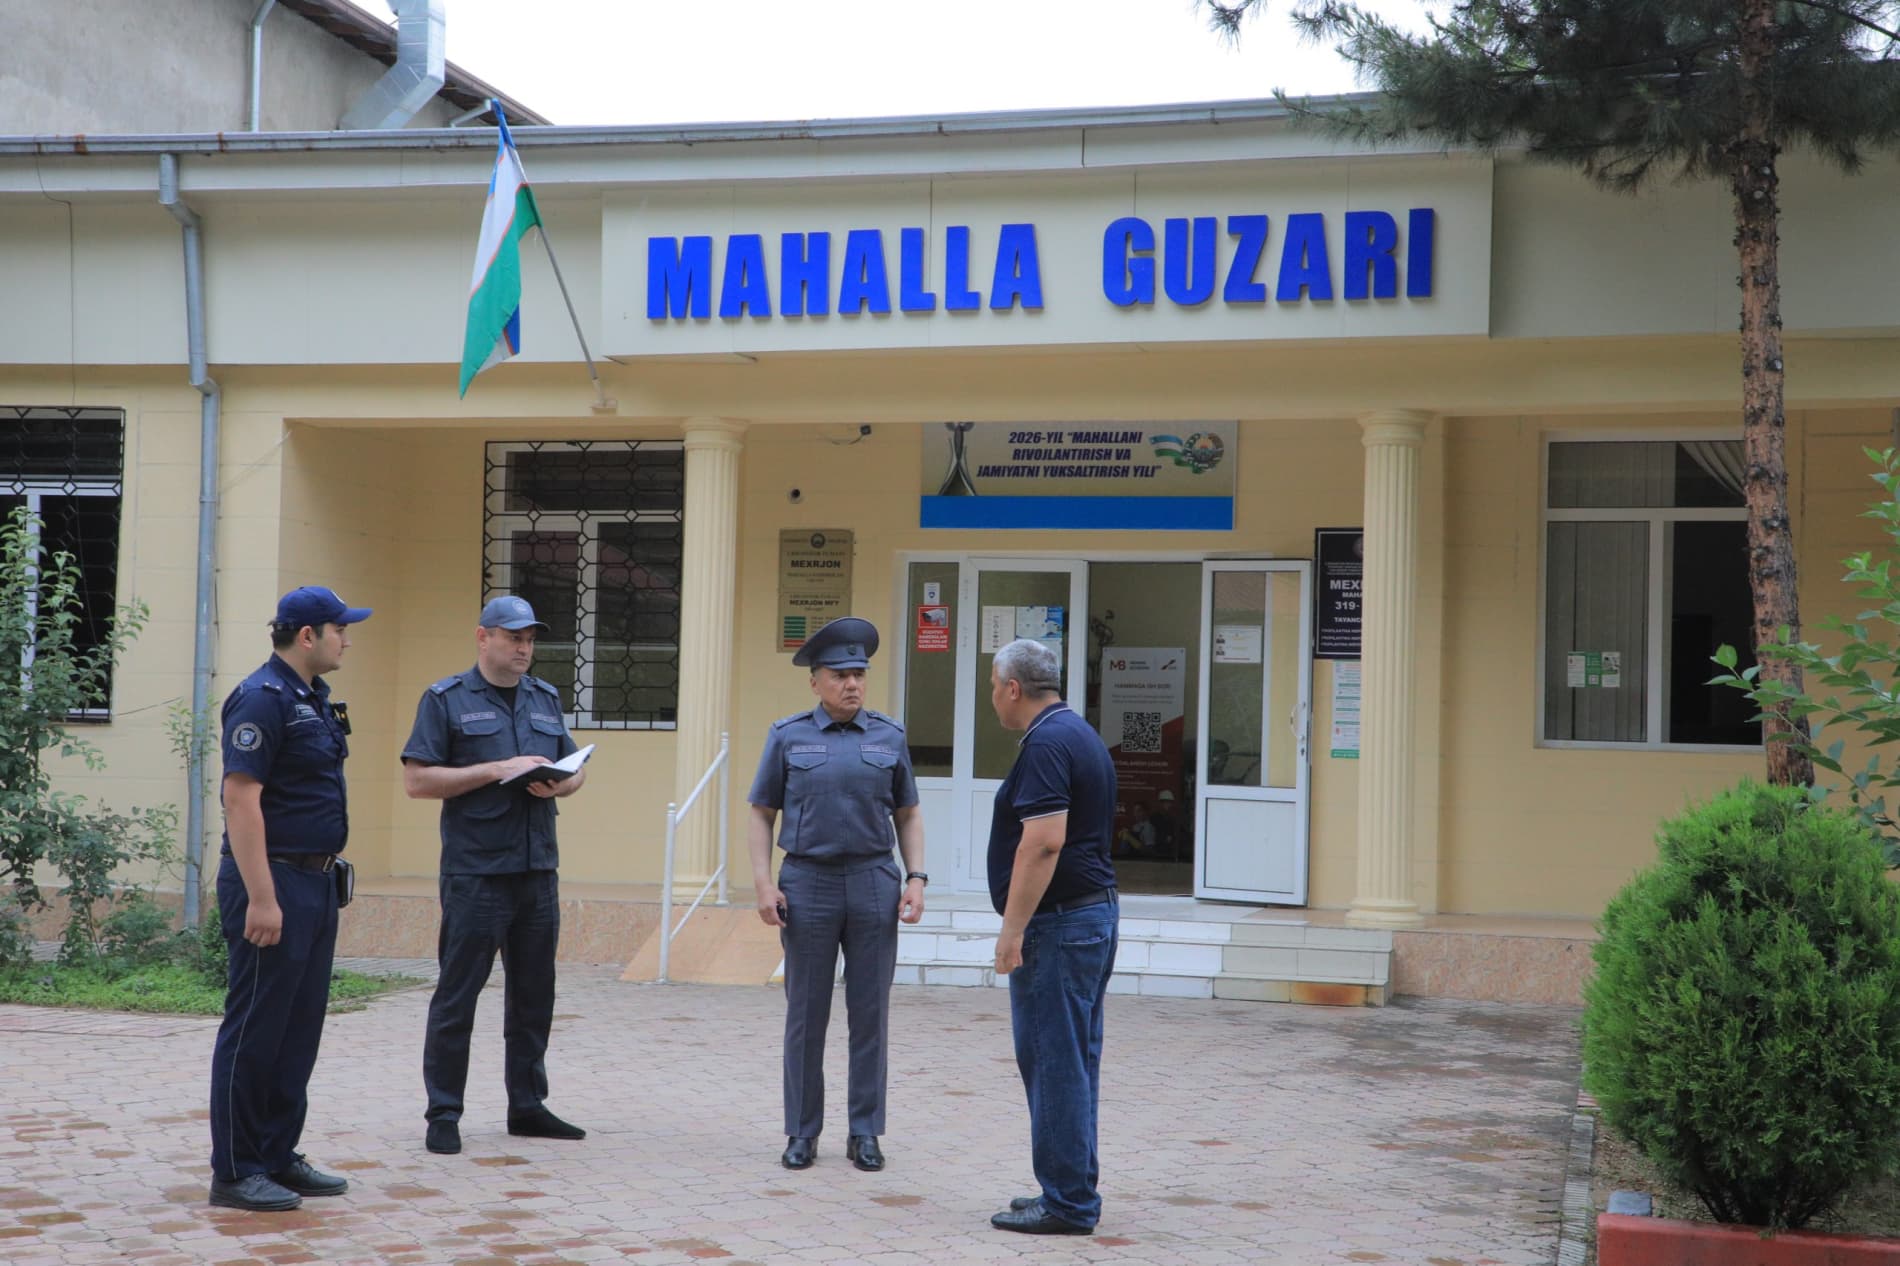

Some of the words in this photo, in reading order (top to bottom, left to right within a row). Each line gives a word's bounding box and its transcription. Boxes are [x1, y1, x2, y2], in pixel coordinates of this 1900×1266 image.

[647, 223, 1045, 320] MAHALLA
[1102, 208, 1436, 308] GUZARI
[1008, 431, 1064, 444] 2026-YIL
[1012, 449, 1112, 461] RIVOJLANTIRISH
[1115, 449, 1131, 461] VA
[976, 465, 1041, 478] JAMIYATNI
[1043, 465, 1130, 478] YUKSALTIRISH
[791, 560, 841, 569] MEXRJON
[1330, 580, 1362, 590] MEX
